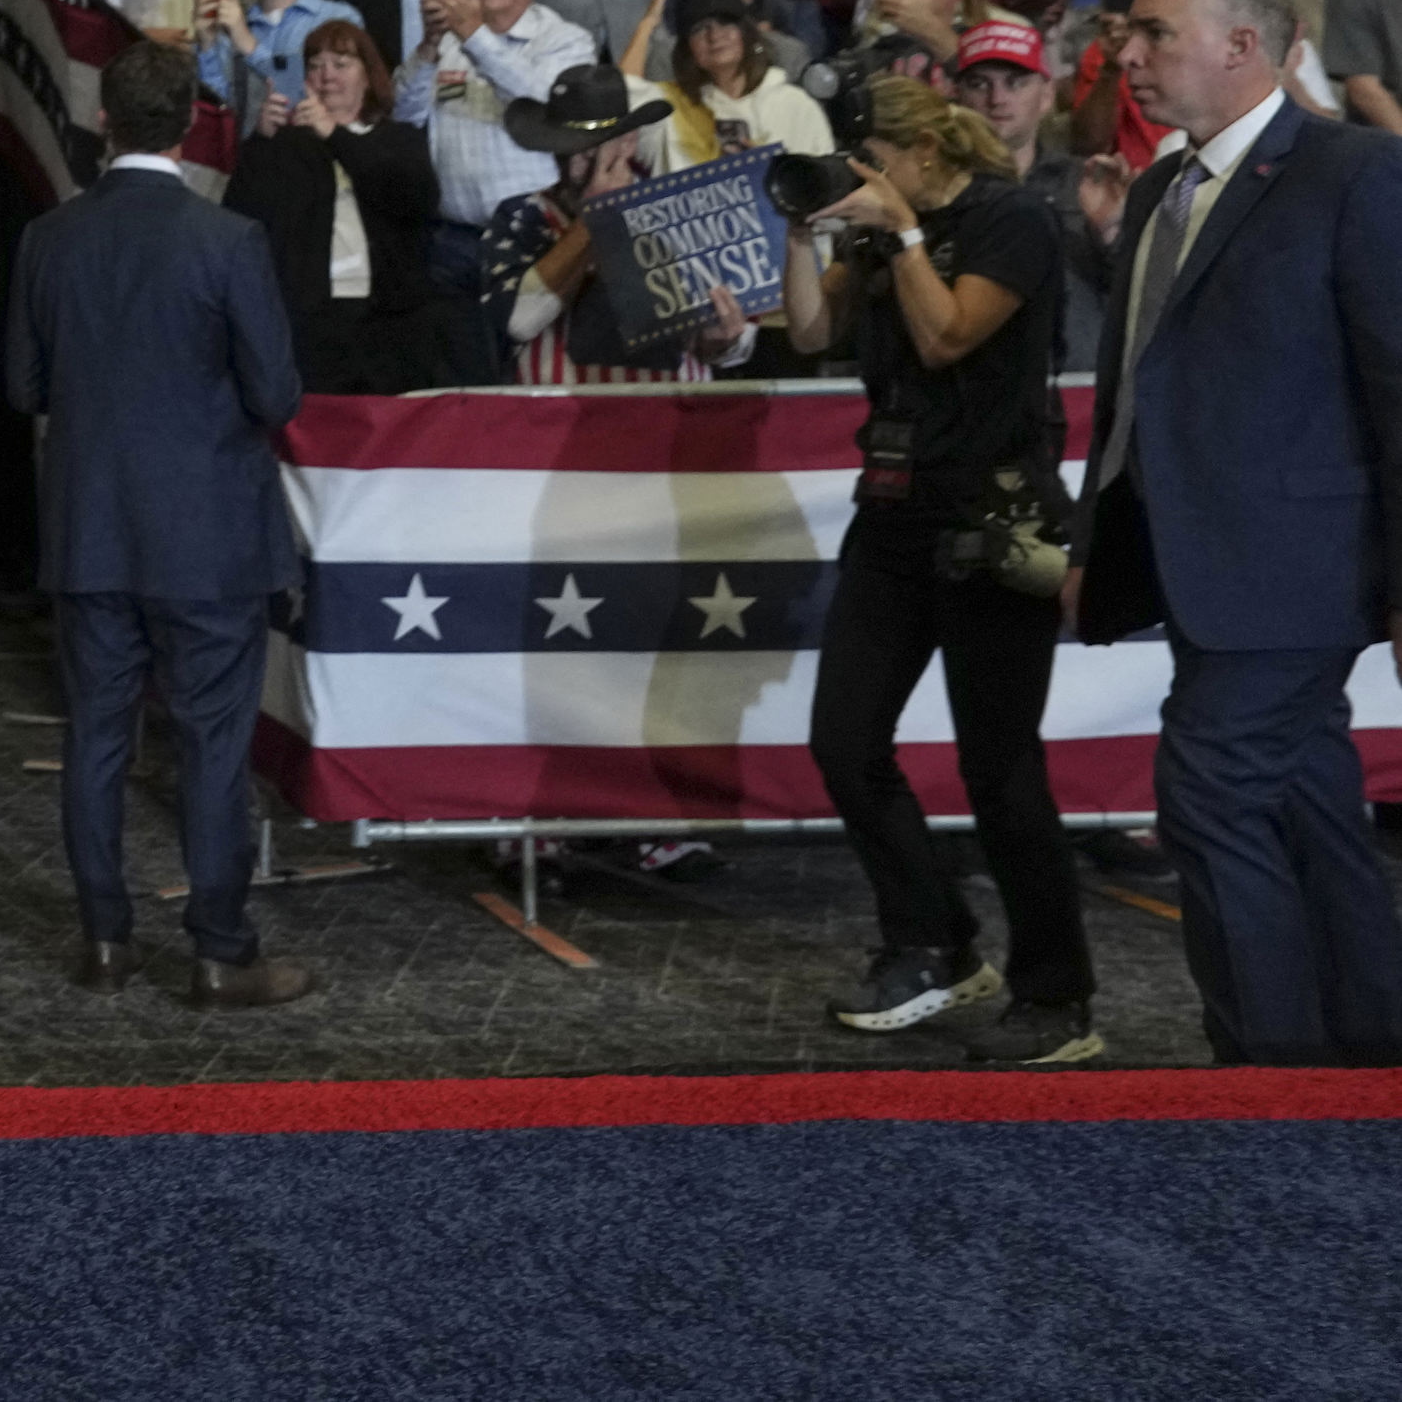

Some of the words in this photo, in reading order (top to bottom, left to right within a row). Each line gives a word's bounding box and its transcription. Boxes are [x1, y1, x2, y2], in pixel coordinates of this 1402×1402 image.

[621, 174, 754, 237] RESTORING
[633, 202, 764, 270] COMMON
[646, 236, 781, 319] SENSE
